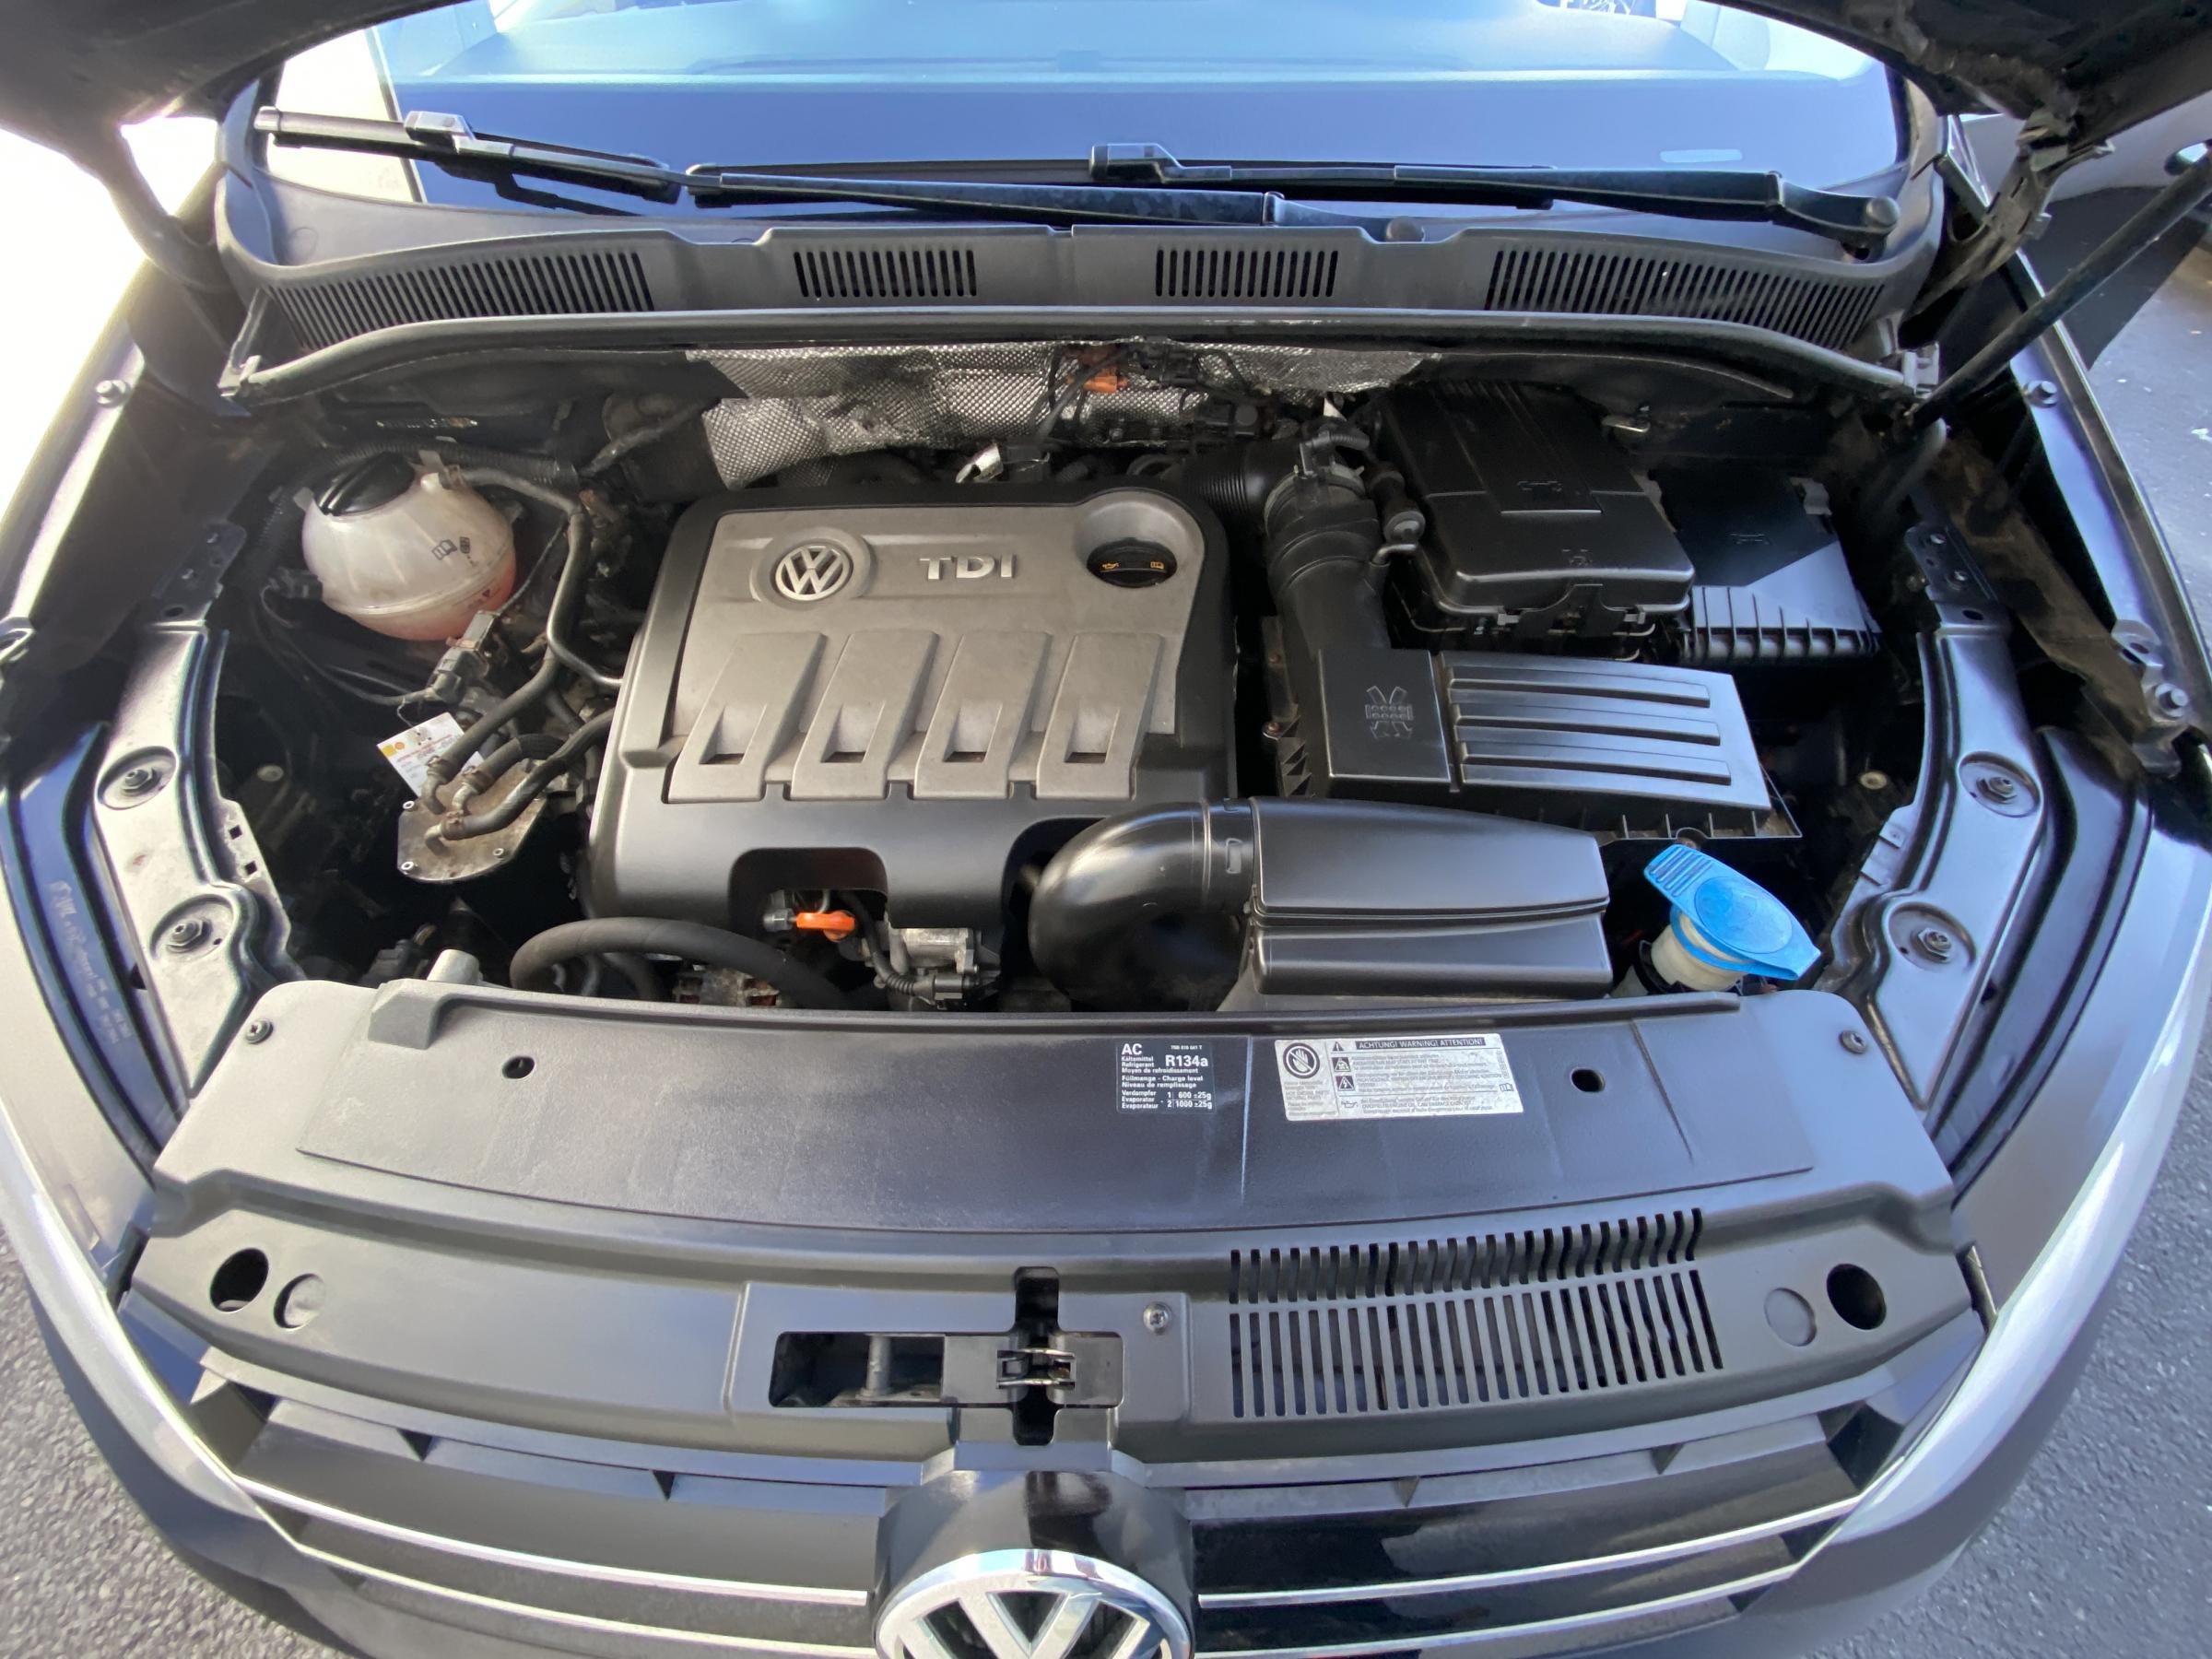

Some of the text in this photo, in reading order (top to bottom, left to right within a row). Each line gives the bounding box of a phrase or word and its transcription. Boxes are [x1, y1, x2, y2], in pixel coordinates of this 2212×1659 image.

[776, 545, 849, 600] VW
[920, 555, 1014, 580] TDI
[1122, 1043, 1143, 1055] AC
[1359, 1037, 1483, 1049] ACHTUNG! WARNING! ATTENTION!
[1165, 1054, 1208, 1067] R134a
